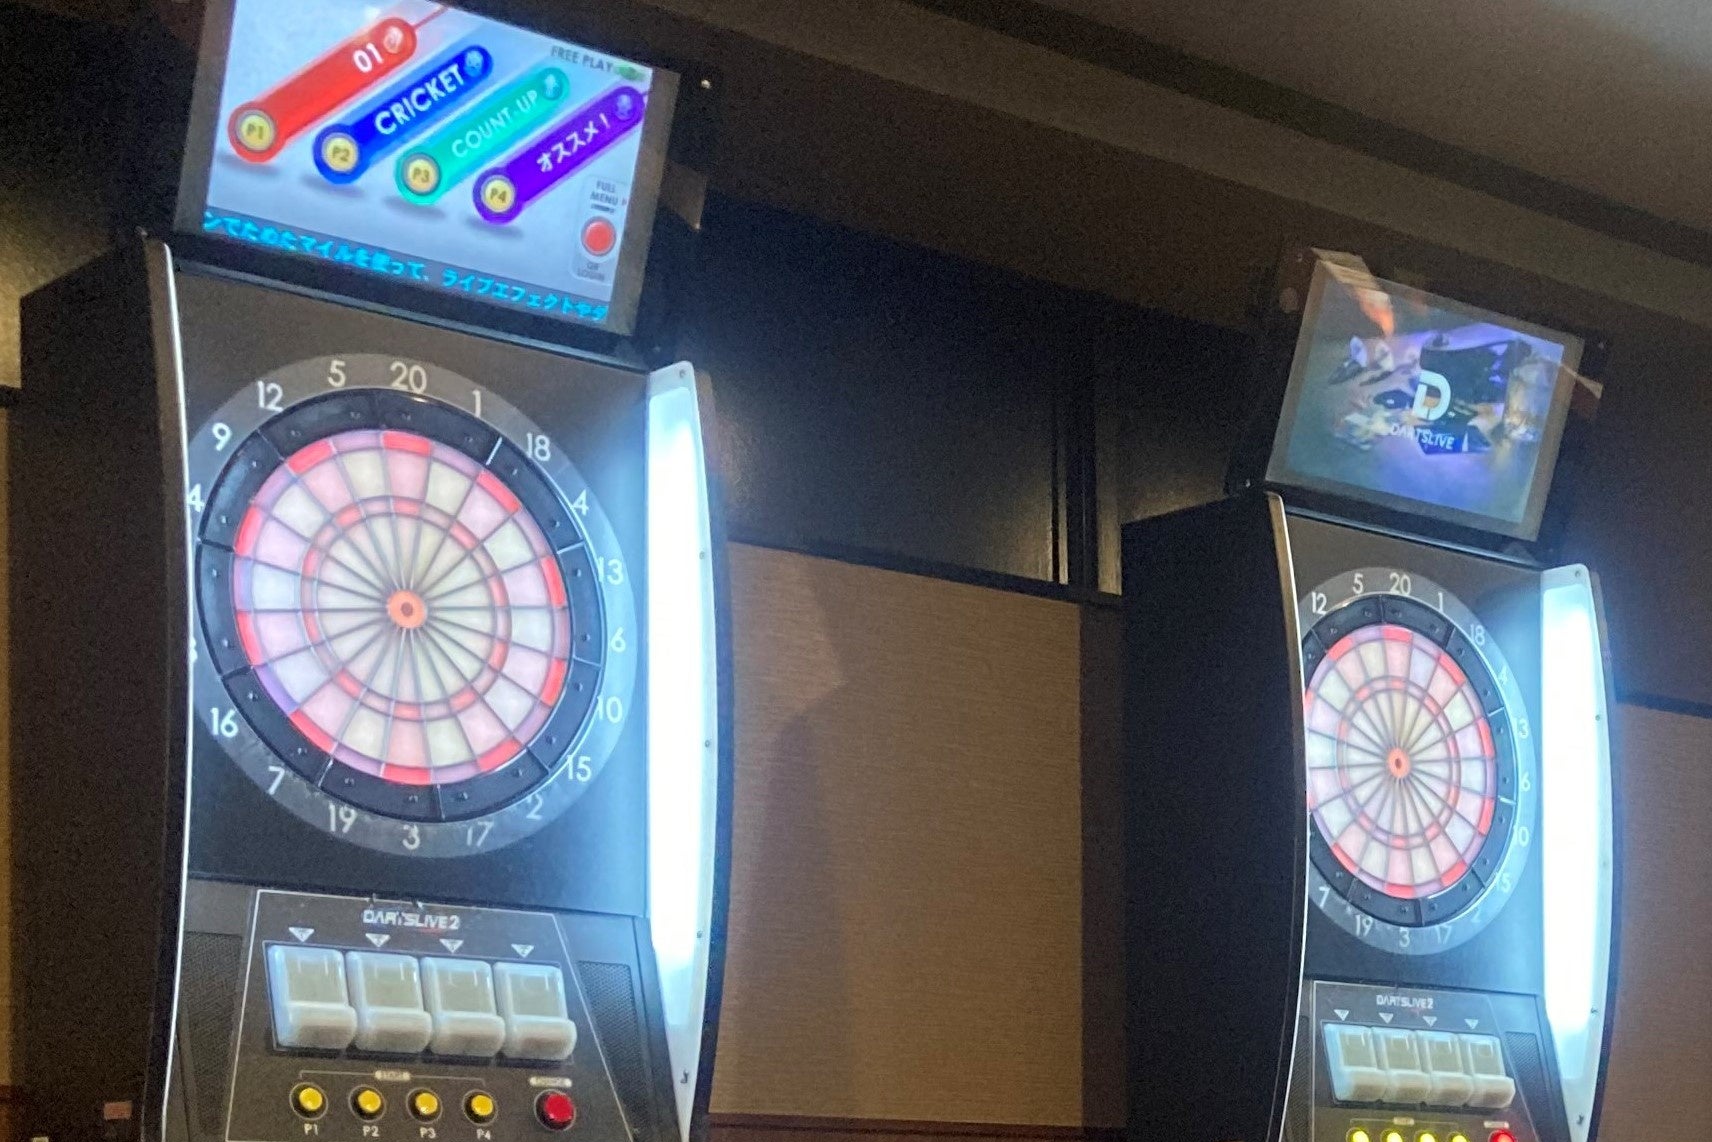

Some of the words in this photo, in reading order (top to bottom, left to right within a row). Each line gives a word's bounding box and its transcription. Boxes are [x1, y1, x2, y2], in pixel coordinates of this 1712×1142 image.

[352, 43, 384, 73] 01
[551, 46, 578, 64] FREE
[583, 55, 614, 73] PLAY
[375, 63, 468, 136] CRICKET
[246, 118, 267, 142] P1
[331, 144, 351, 164] P2
[412, 166, 431, 183] P3
[489, 187, 508, 204] P4
[328, 361, 346, 387] 5
[390, 362, 427, 392] 20
[257, 381, 284, 412] 12
[472, 391, 482, 418] 1
[212, 423, 232, 450] 9
[526, 433, 551, 460] 18
[571, 490, 589, 516] 4
[597, 556, 624, 585] 13
[1353, 573, 1364, 594] 5
[1389, 573, 1412, 596] 20
[1311, 592, 1327, 615] 12
[1437, 592, 1445, 613] 1
[610, 627, 626, 652] 6
[1469, 624, 1486, 646] 18
[597, 694, 622, 723] 10
[210, 707, 239, 738] 16
[267, 766, 285, 794] 7
[566, 755, 592, 782] 15
[1520, 772, 1531, 792] 6
[526, 793, 543, 820] 2
[328, 804, 358, 834] 19
[402, 825, 421, 849] 3
[466, 820, 494, 847] 17
[1318, 886, 1331, 908] 7
[363, 909, 460, 930] DARTSLIVE2
[1355, 914, 1374, 935] 19
[1399, 928, 1410, 948] 3
[1376, 995, 1433, 1009] DARTSLIVE2
[304, 1123, 318, 1136] P1
[362, 1126, 379, 1137] P2
[420, 1127, 436, 1139] P3
[476, 1128, 491, 1140] P4
